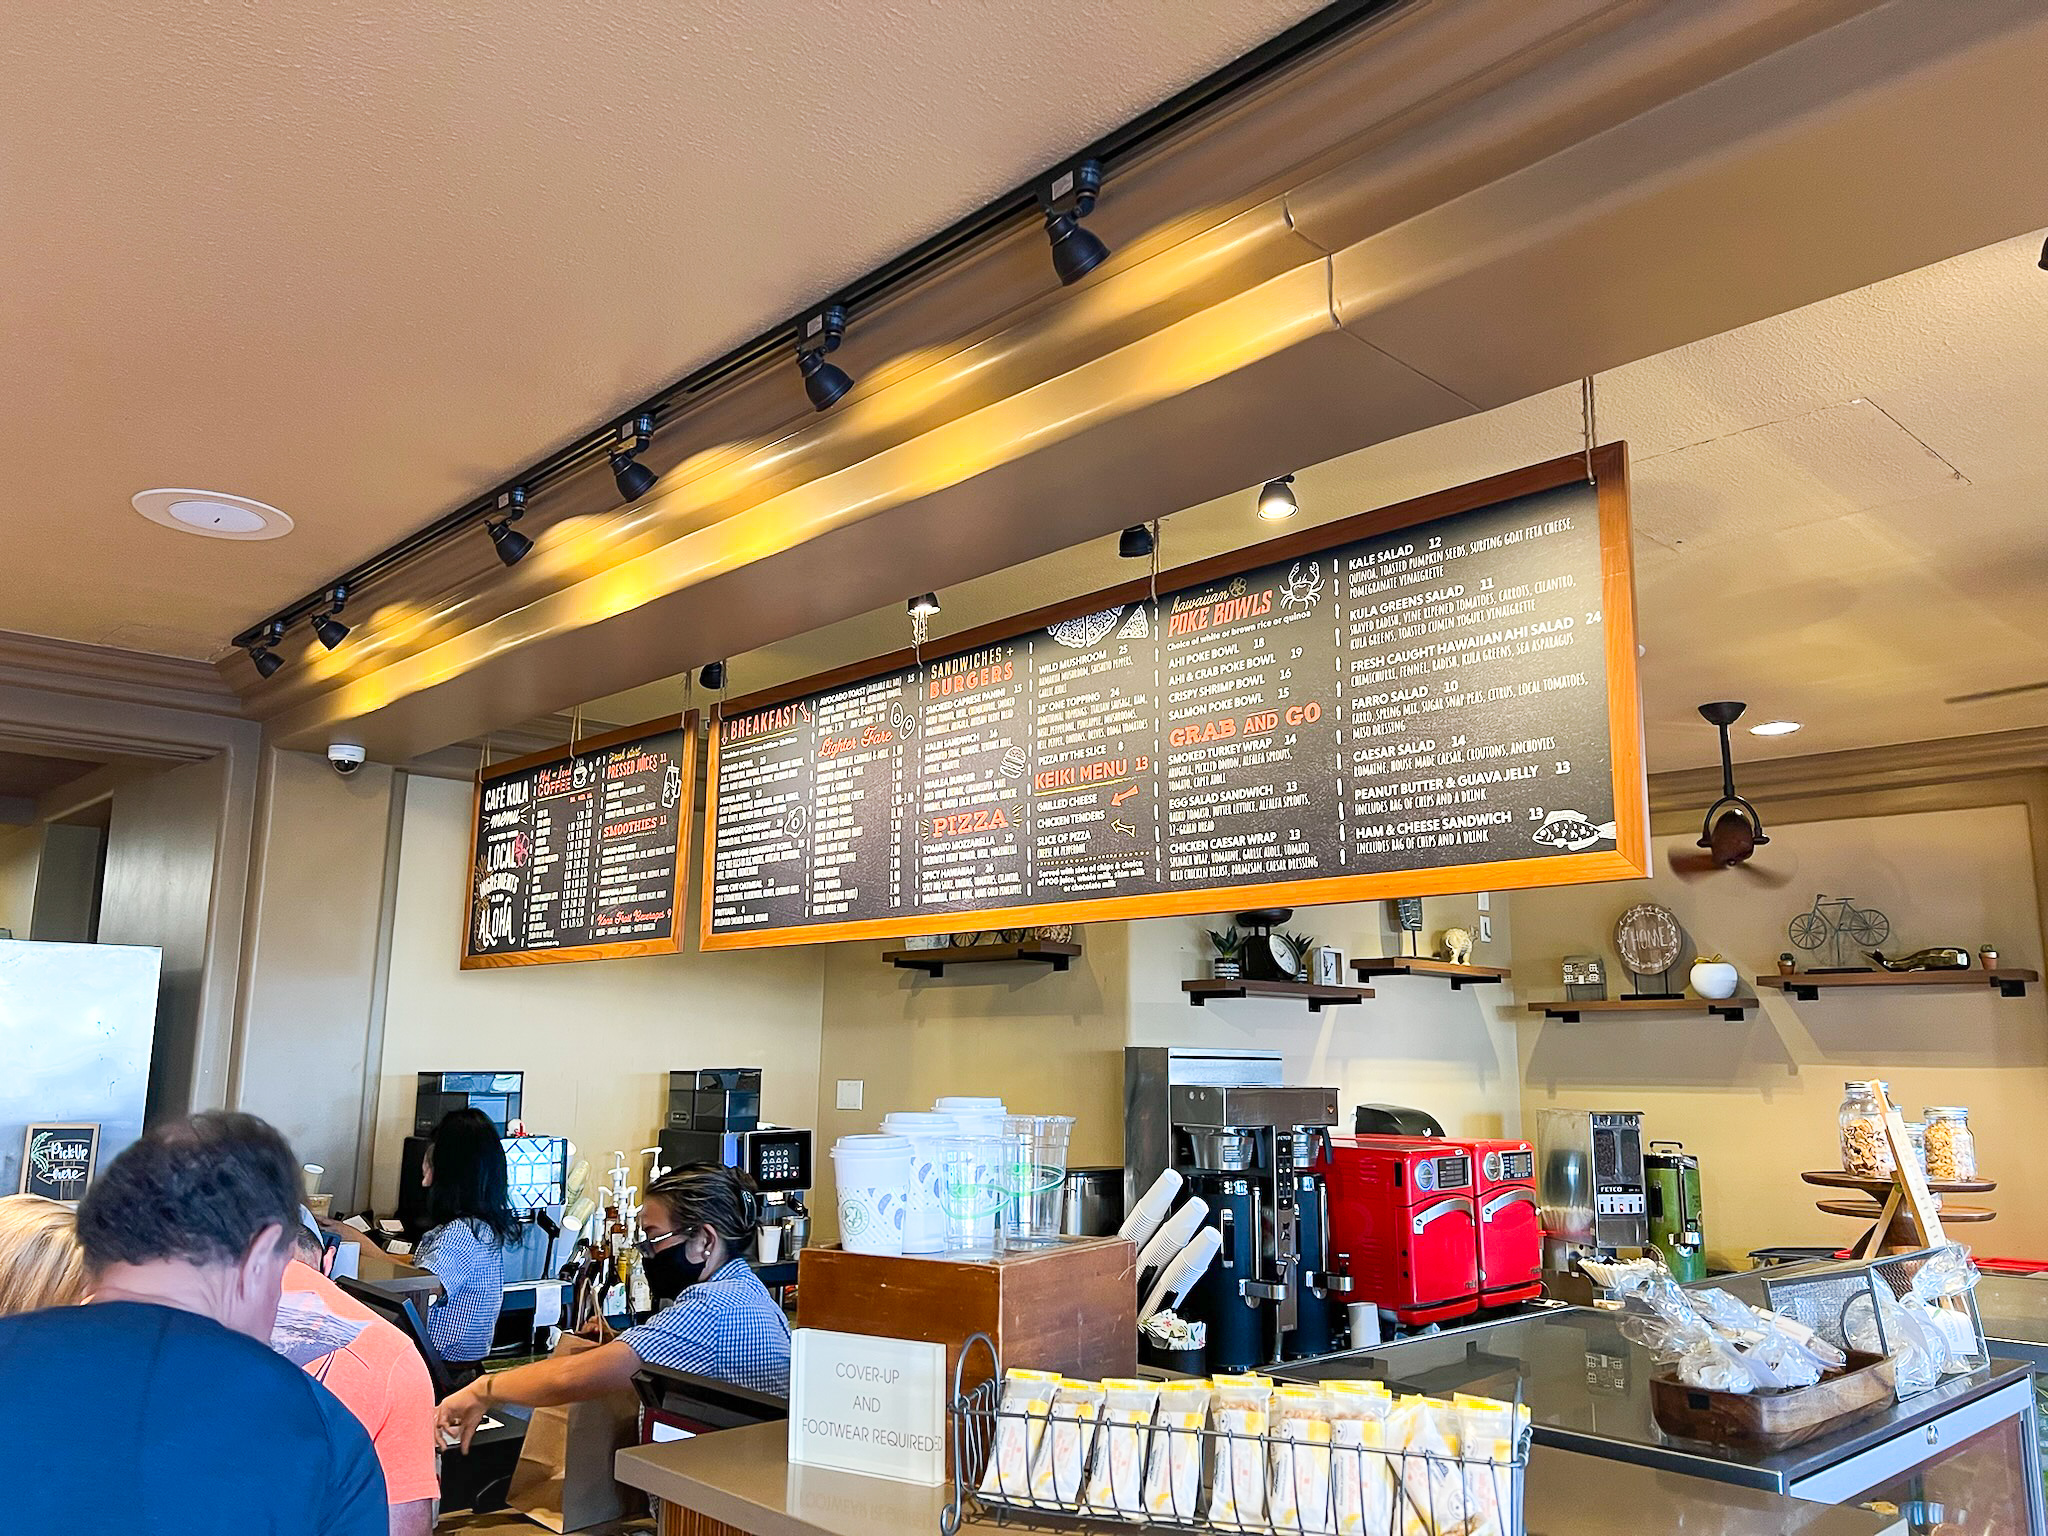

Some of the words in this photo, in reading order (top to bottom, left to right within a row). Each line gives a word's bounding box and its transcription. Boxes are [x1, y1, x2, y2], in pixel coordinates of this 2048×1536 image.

[1349, 554, 1376, 570] KALE
[1377, 544, 1414, 562] SALAD
[1429, 537, 1441, 549] 12
[1349, 576, 1397, 599] POMEGRANATE
[1400, 565, 1443, 587] VINAIGRETTE
[1168, 607, 1210, 637] POKE
[1212, 590, 1273, 626] BOWLS
[1350, 604, 1378, 621] KULA
[1380, 594, 1423, 614] GREENS
[1426, 585, 1464, 603] SALAD
[1481, 578, 1494, 589] 11
[1167, 636, 1190, 651] Choice
[1191, 634, 1199, 645] of
[1200, 629, 1220, 643] white
[1222, 627, 1230, 638] or
[1232, 622, 1255, 636] brown
[1257, 618, 1271, 630] rice
[1273, 616, 1282, 626] or
[1283, 610, 1311, 623] quinoa
[1350, 636, 1366, 651] KULA
[1399, 623, 1426, 640] TOASTED
[1428, 617, 1454, 634] CUMIN
[1457, 610, 1484, 628] YOGURT
[1486, 599, 1535, 622] VINAIGRETTE
[1168, 655, 1185, 668] AHI
[1186, 650, 1210, 664] POKE
[1211, 643, 1239, 659] BOWL
[1254, 638, 1265, 650] 18
[1351, 655, 1384, 672] FRESH
[1387, 645, 1434, 665] CAUGHT
[1437, 631, 1502, 655] HAWAIIAN
[1504, 626, 1528, 641] AHI
[1531, 617, 1573, 636] SALAD
[1586, 611, 1601, 624] 24
[931, 647, 1002, 679] SANDWICHES
[1038, 662, 1058, 675] WILD
[1060, 650, 1106, 670] MUSHROOM
[1118, 644, 1128, 655] 25
[1168, 673, 1184, 686] AHI
[1186, 671, 1193, 682] &
[1195, 665, 1219, 680] CRAB
[1220, 660, 1245, 675] POKE
[1247, 653, 1276, 669] BOWL
[1291, 647, 1302, 659] 19
[848, 686, 866, 699] TOAST
[930, 661, 1013, 699] BURGERS
[982, 688, 1005, 701] PANINI
[1014, 684, 1022, 694] 15
[1168, 687, 1198, 703] CRISPY
[1199, 680, 1235, 697] SHRIMP
[1236, 674, 1265, 689] BOWL
[1280, 668, 1291, 680] 16
[1352, 693, 1388, 710] FARRO
[1392, 686, 1428, 703] SALAD
[1444, 680, 1458, 694] 10
[1168, 704, 1207, 721] SALMON
[1208, 698, 1233, 713] POKE
[1234, 693, 1263, 708] BOWL
[1278, 688, 1289, 700] 15
[731, 704, 798, 740] BREAKFAST
[1169, 718, 1236, 747] GRAB
[1244, 712, 1278, 735] AND
[1285, 701, 1321, 726] GO
[1352, 726, 1370, 740] MISO
[1372, 720, 1405, 737] DRESSING
[818, 737, 857, 759] Lighter
[861, 726, 893, 747] Fare
[1038, 753, 1058, 766] PIZZA
[1059, 751, 1068, 762] BY
[1070, 748, 1085, 761] THE
[1086, 744, 1106, 758] SLICE
[1168, 749, 1205, 765] SMOKED
[1207, 743, 1241, 759] TURKEY
[1243, 738, 1272, 753] WRAP
[1284, 734, 1296, 746] 14
[1353, 745, 1395, 762] CAESAR
[1398, 739, 1435, 755] SALAD
[1451, 735, 1466, 748] 14
[607, 760, 635, 779] PRESSED
[635, 753, 657, 773] JUICES
[660, 753, 667, 763] 11
[1034, 768, 1075, 789] KEIKI
[1080, 759, 1128, 782] MENU
[1136, 756, 1148, 771] 13
[1355, 784, 1398, 800] PEANUT
[1400, 778, 1443, 794] BUTTER
[1446, 776, 1455, 789] &
[1458, 770, 1502, 787] GUAVA
[1504, 765, 1538, 781] JELLY
[1556, 761, 1570, 775] 13
[485, 782, 506, 811] CAFÉ
[507, 780, 528, 806] KULA
[538, 778, 571, 796] COFFEE
[1169, 797, 1187, 809] EGG
[1189, 792, 1218, 807] SALAD
[1220, 785, 1273, 803] SANDWICH
[1286, 781, 1297, 794] 13
[1037, 798, 1068, 812] GRILLED
[1069, 794, 1098, 808] CHEESE
[490, 809, 520, 829] menu
[604, 817, 657, 838] SMOOTHIES
[660, 815, 667, 825] 11
[933, 808, 1008, 838] PIZZA
[1037, 815, 1069, 829] CHICKEN
[1071, 810, 1105, 824] TENDERS
[1356, 825, 1383, 838] HAM
[1386, 824, 1394, 835] &
[1398, 819, 1440, 834] CHEESE
[1442, 811, 1511, 830] SANDWICH
[1529, 808, 1543, 820] 13
[923, 842, 951, 854] TOMATO
[952, 836, 995, 850] MOZZARELLA
[1037, 834, 1056, 846] SLICE
[1057, 833, 1068, 844] OF
[1069, 830, 1092, 842] PIZZA
[1169, 840, 1208, 854] CHICKEN
[1210, 836, 1246, 850] CAESAR
[1248, 832, 1277, 846] WRAP
[1289, 829, 1300, 841] 13
[487, 840, 519, 871] LOCAL
[480, 872, 519, 899] INGREDIENTS
[478, 896, 515, 947] ALOHA
[1630, 926, 1668, 951] HOME
[52, 1168, 80, 1179] here
[836, 1363, 899, 1384] COVER-UP
[853, 1396, 880, 1413] AND
[802, 1418, 869, 1442] FOOTWEAR
[873, 1430, 934, 1452] REQUIRED
